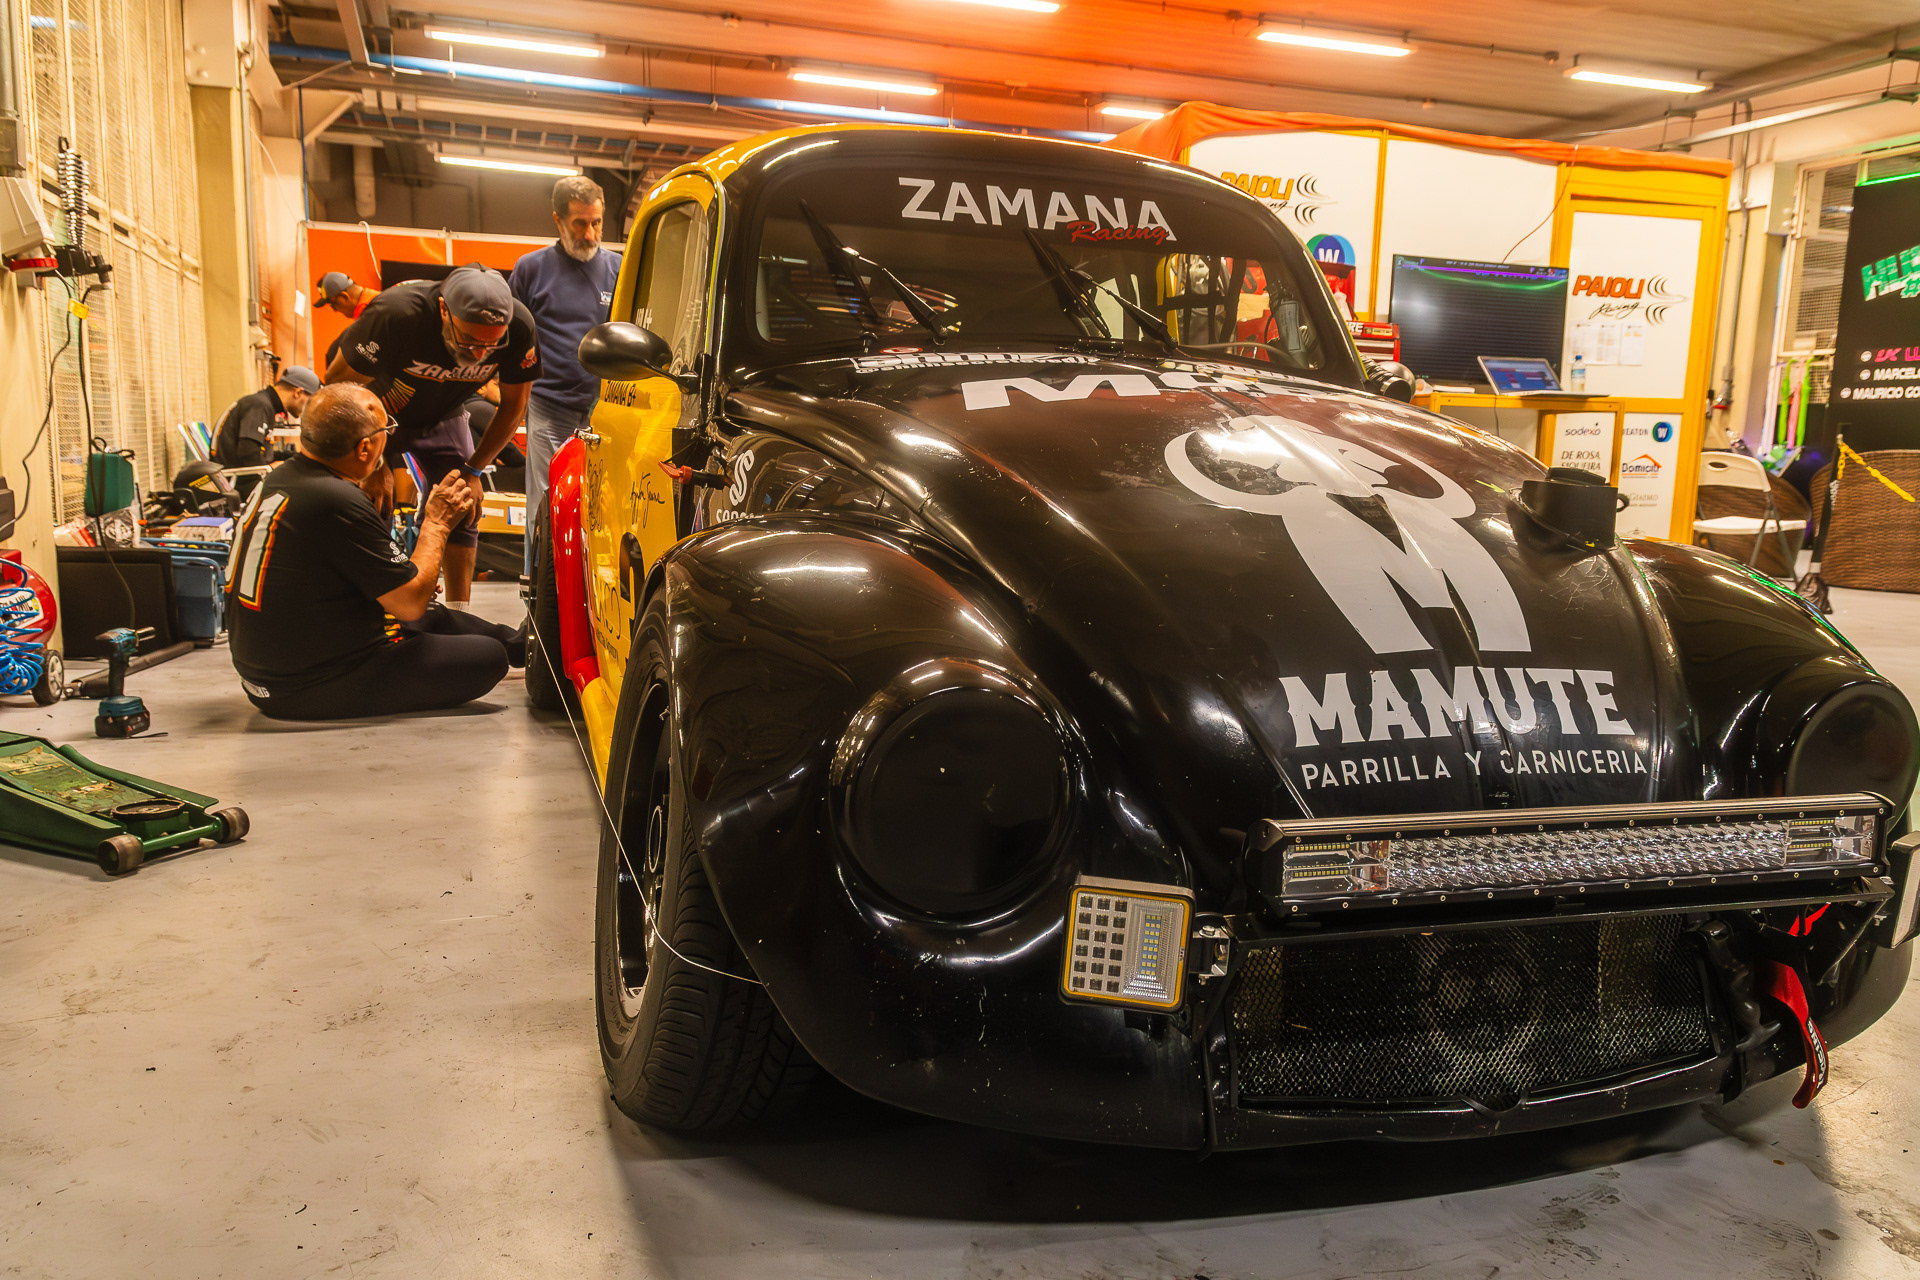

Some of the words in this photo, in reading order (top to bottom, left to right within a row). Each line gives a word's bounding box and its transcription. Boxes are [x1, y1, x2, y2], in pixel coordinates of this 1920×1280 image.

[899, 177, 1177, 241] ZAMANA
[1067, 220, 1169, 245] Racing
[1572, 275, 1645, 299] PAIOLI
[1588, 302, 1644, 320] Racing
[1565, 426, 1601, 436] sodexo
[1561, 450, 1575, 460] DE
[1576, 450, 1601, 460] ROSA
[1279, 666, 1636, 748] MAMUTE
[1301, 755, 1452, 790] PARRILLA
[1464, 751, 1482, 776] Y
[1500, 749, 1648, 775] CARNICERIA
